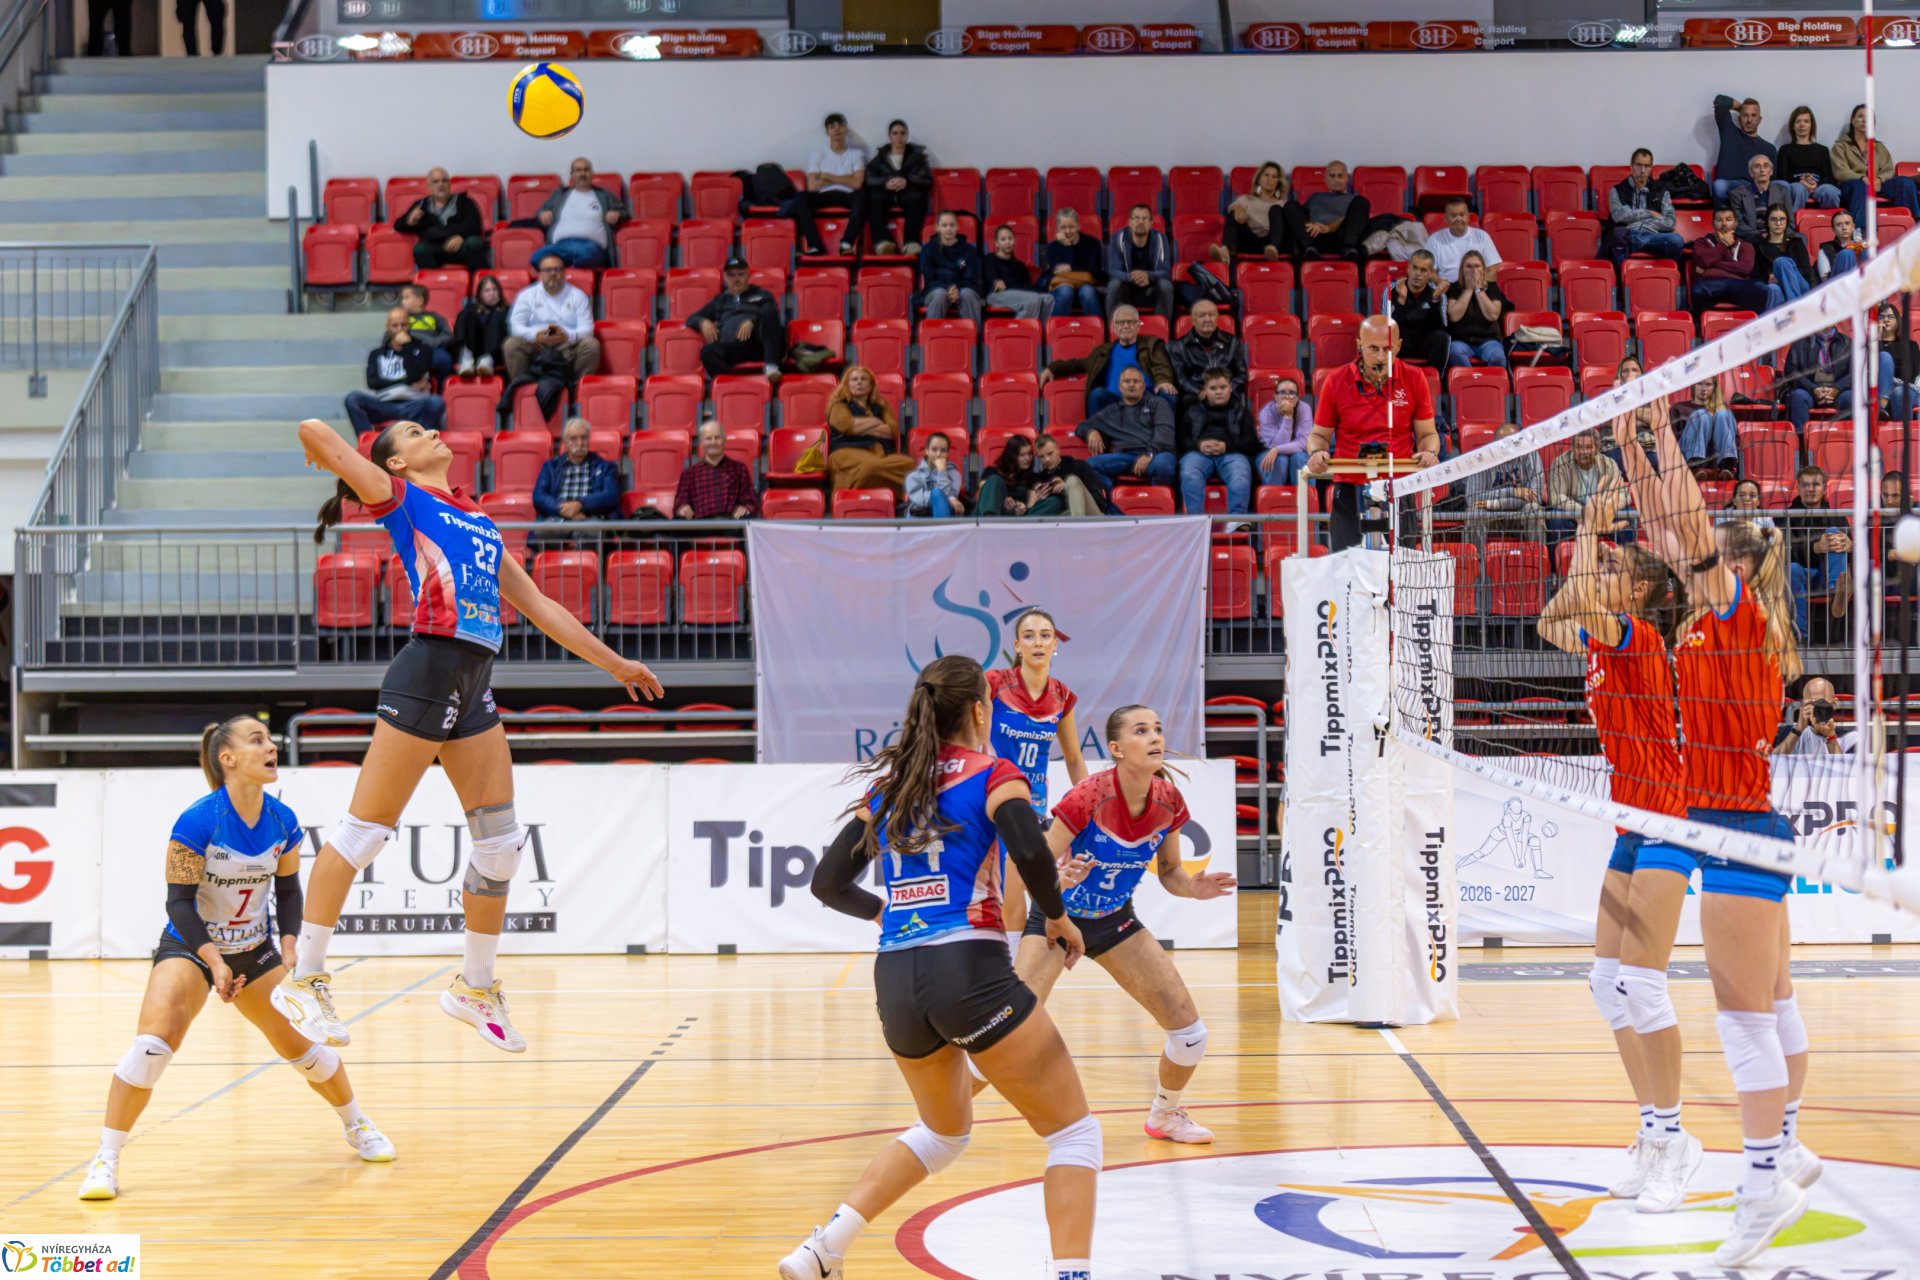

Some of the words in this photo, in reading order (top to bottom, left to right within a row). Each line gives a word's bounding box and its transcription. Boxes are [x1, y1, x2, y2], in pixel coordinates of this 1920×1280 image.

[1418, 27, 1449, 46] BH
[1577, 25, 1608, 43] BH
[1733, 23, 1763, 42] BH
[1777, 21, 1801, 34] Bige
[1803, 21, 1842, 34] Holding
[461, 37, 490, 55] BH
[504, 34, 528, 46] Bige
[532, 34, 568, 46] Holding
[688, 33, 727, 45] Holding
[1096, 31, 1126, 49] BH
[1261, 28, 1290, 47] BH
[1789, 33, 1830, 45] Csoport
[515, 46, 556, 58] Csoport
[674, 45, 715, 57] Csoport
[1316, 599, 1346, 756] TippmixPRO
[1018, 742, 1039, 768] 10
[1098, 869, 1122, 891] 3
[1460, 885, 1492, 902] 2026
[1504, 885, 1536, 902] 2027
[235, 889, 254, 918] 7
[1324, 827, 1350, 984] TippmixPRO
[1420, 826, 1447, 983] TippmixPRO
[507, 917, 551, 931] KFT
